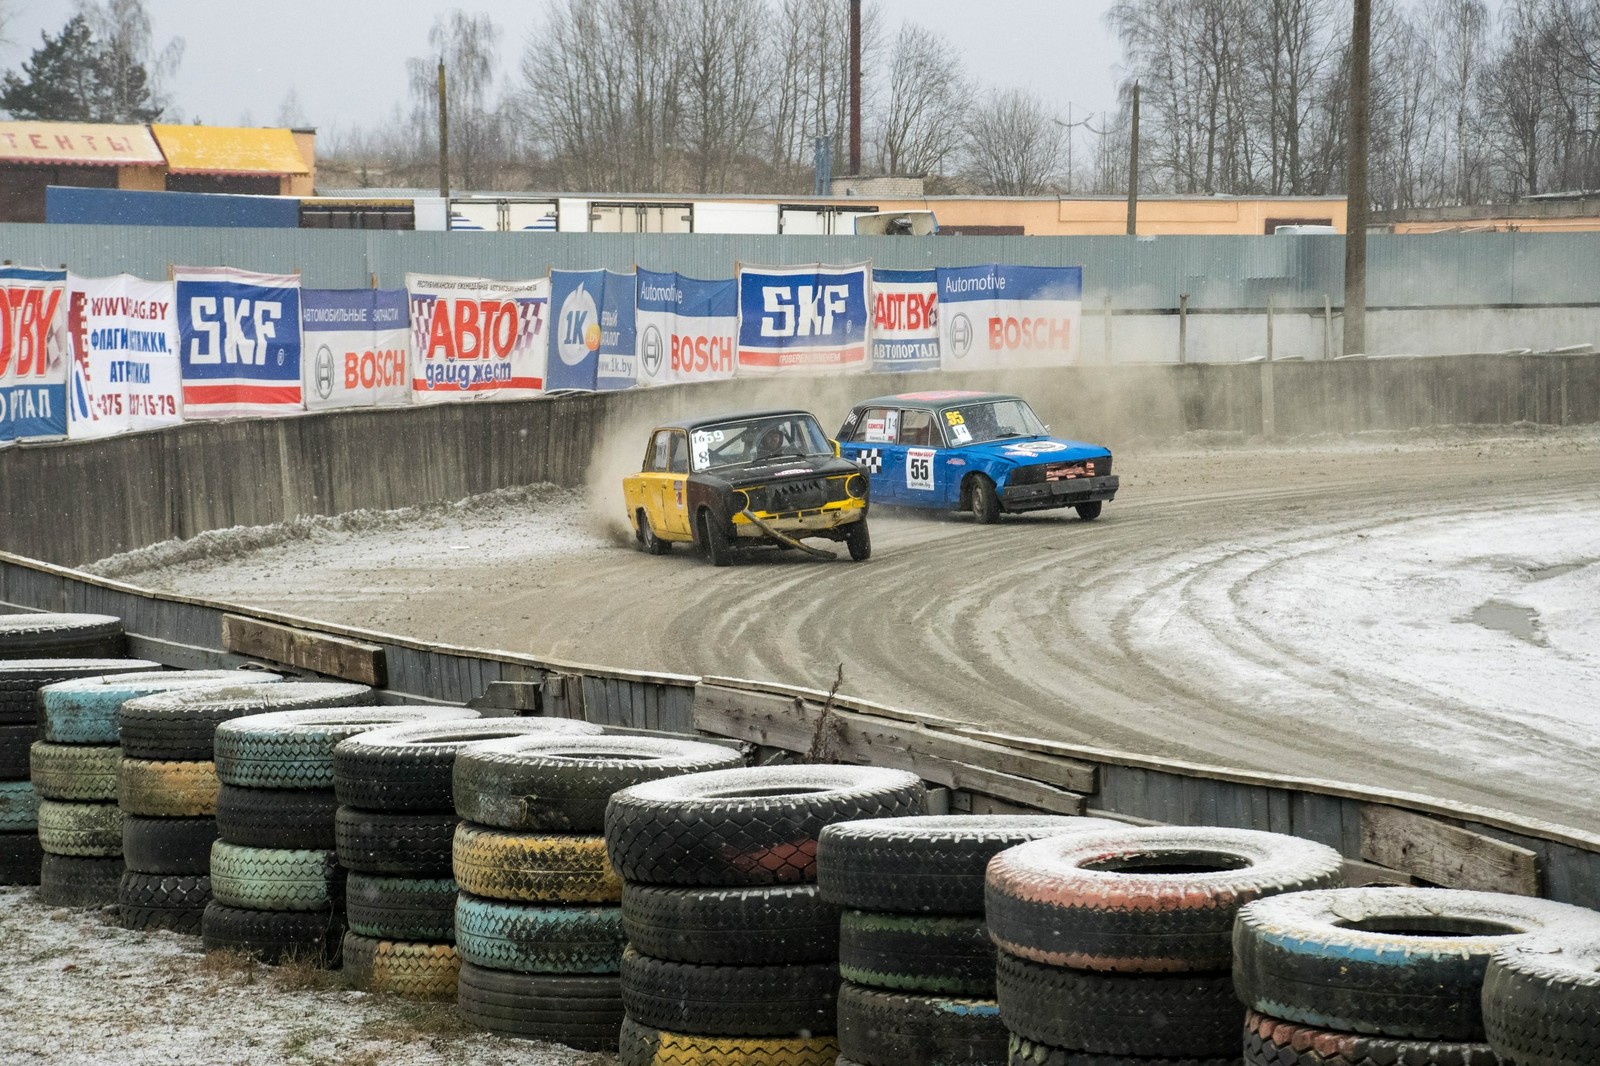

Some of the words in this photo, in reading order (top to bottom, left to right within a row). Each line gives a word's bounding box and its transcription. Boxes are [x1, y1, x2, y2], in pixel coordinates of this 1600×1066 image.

[641, 281, 683, 304] Automotive
[945, 273, 1006, 292] Automotive
[303, 308, 367, 322] АВТОМОБИЛЬНЫЕ
[760, 284, 848, 337] SKF
[190, 296, 282, 365] SKF
[426, 299, 519, 360] АВТО
[988, 316, 1071, 350] BOSCH
[671, 334, 733, 373] BOSCH
[873, 343, 938, 359] АВТОПОРТАЛ
[345, 349, 405, 389] BOSCH
[944, 411, 965, 426] 55
[911, 458, 929, 481] 55
